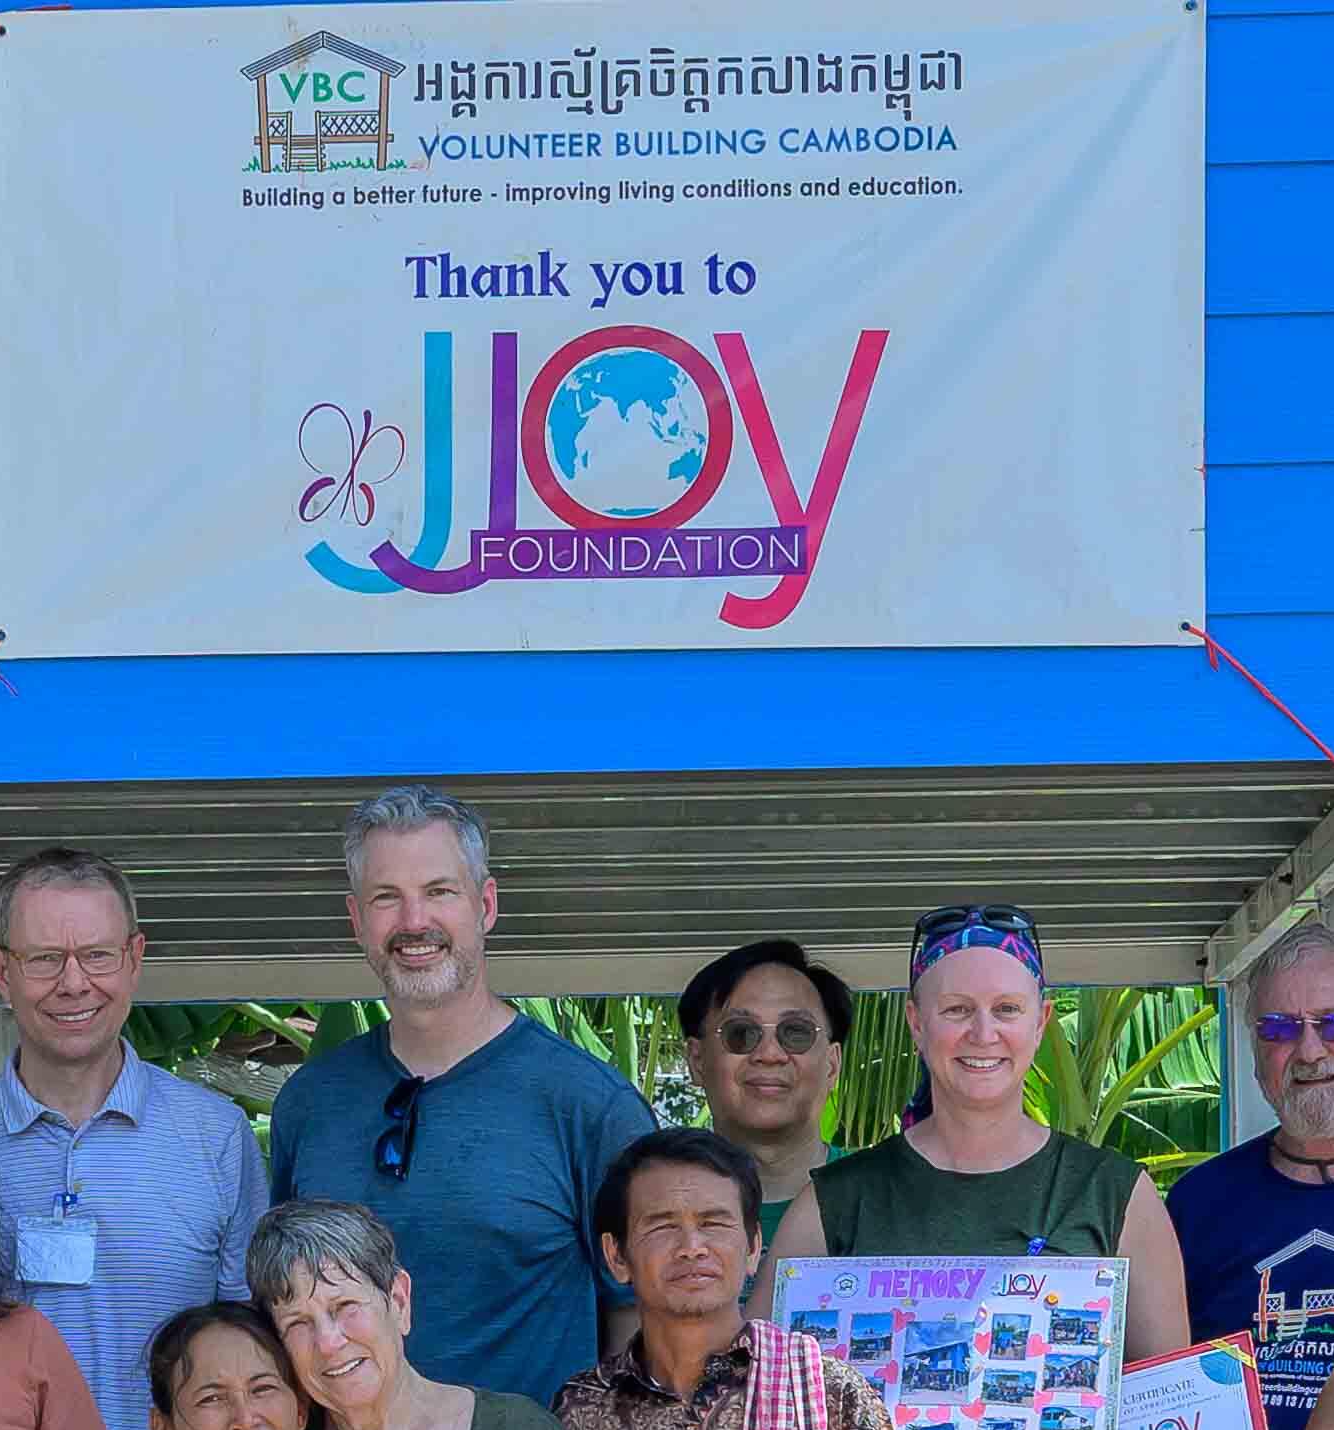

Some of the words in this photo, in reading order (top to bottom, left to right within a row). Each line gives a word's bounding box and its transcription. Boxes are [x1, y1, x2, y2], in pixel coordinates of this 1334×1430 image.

[279, 70, 366, 104] VBC
[418, 130, 602, 160] VOLUNTEER
[615, 128, 767, 157] BUILDING
[778, 125, 959, 153] CAMBODIA
[242, 187, 325, 210] Building
[332, 190, 346, 205] a
[353, 186, 416, 205] better
[422, 185, 483, 203] future
[505, 182, 612, 206] improving
[618, 181, 675, 203] living
[682, 179, 793, 200] conditions
[800, 178, 840, 197] and
[847, 176, 964, 196] education.
[404, 250, 571, 299] Thank
[589, 260, 685, 309] you
[704, 252, 758, 296] to
[480, 533, 800, 573] FOUNDATION
[868, 1269, 987, 1299] MEMORY
[1268, 1360, 1324, 1374] BUILDING
